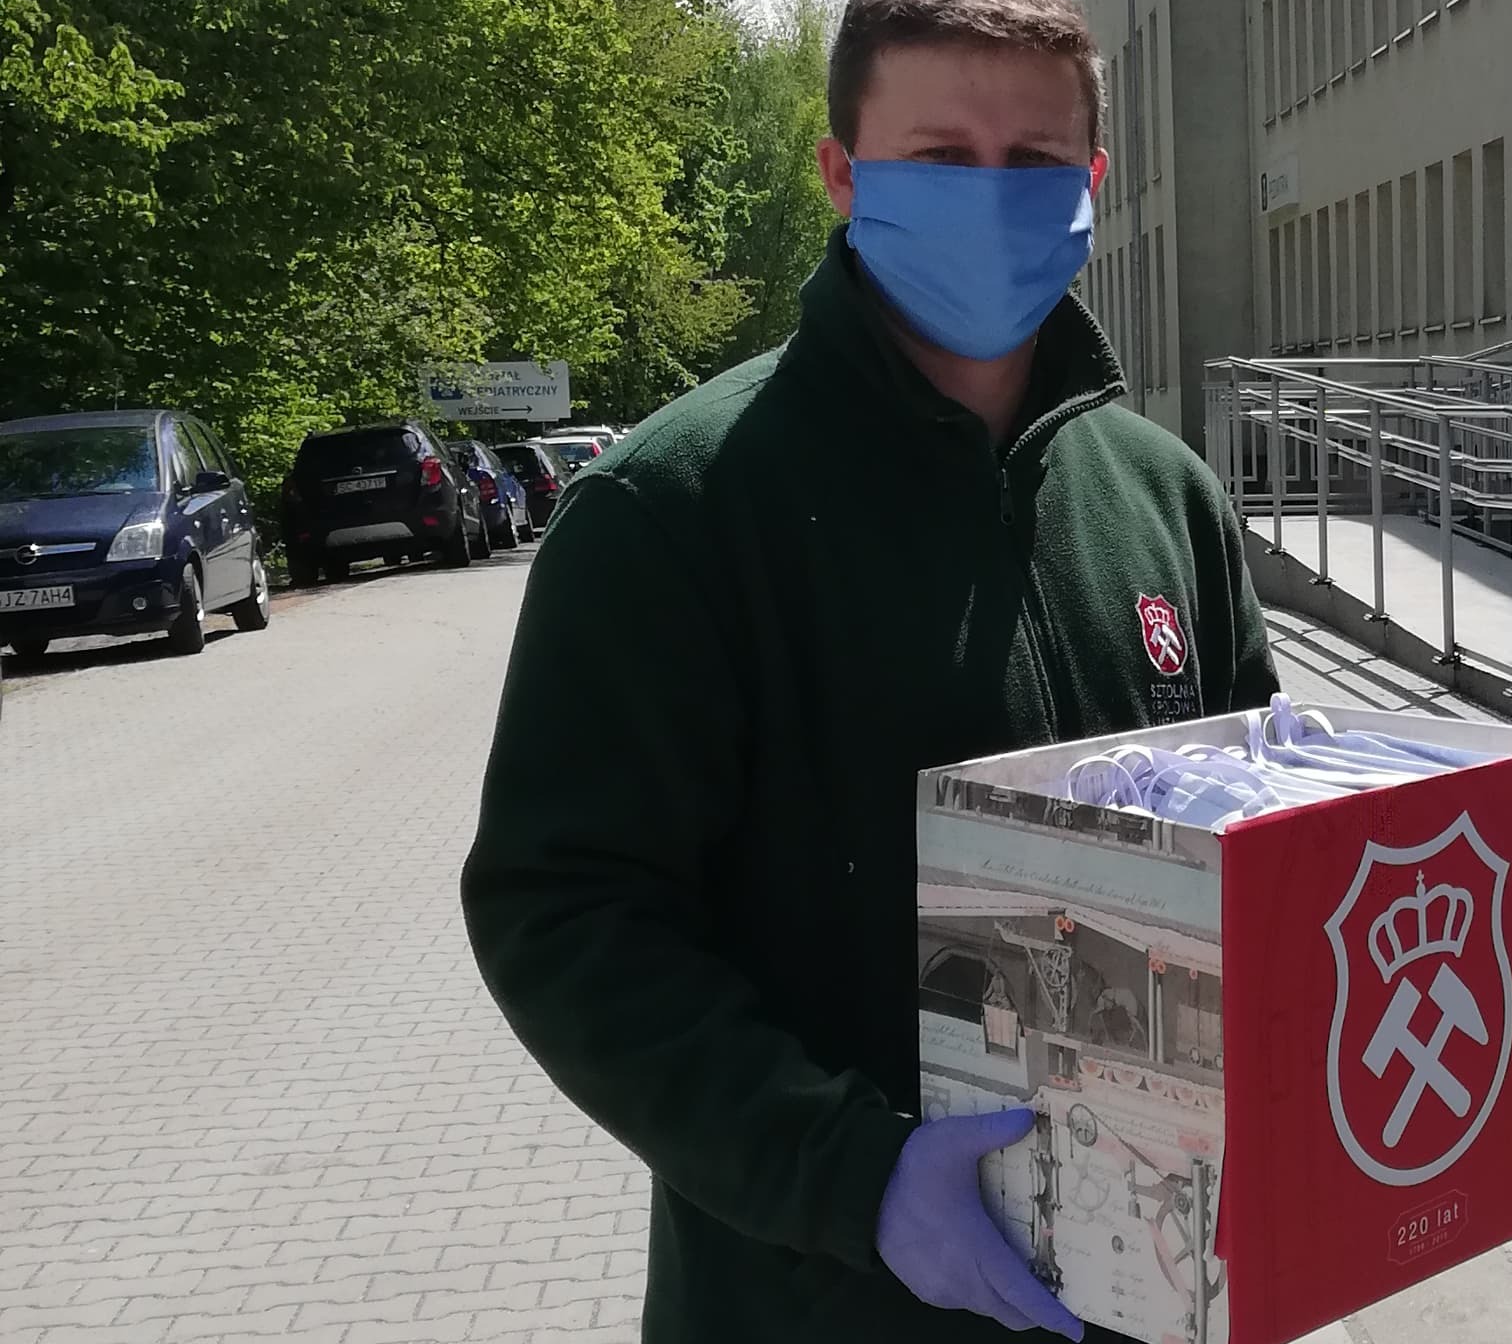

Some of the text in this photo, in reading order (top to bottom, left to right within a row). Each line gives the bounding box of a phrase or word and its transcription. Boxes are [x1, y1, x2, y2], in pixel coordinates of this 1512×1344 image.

[458, 406, 500, 416] WEJŚCIE
[0, 588, 70, 607] JZ 7AH4
[1397, 1202, 1459, 1247] 220 lat
